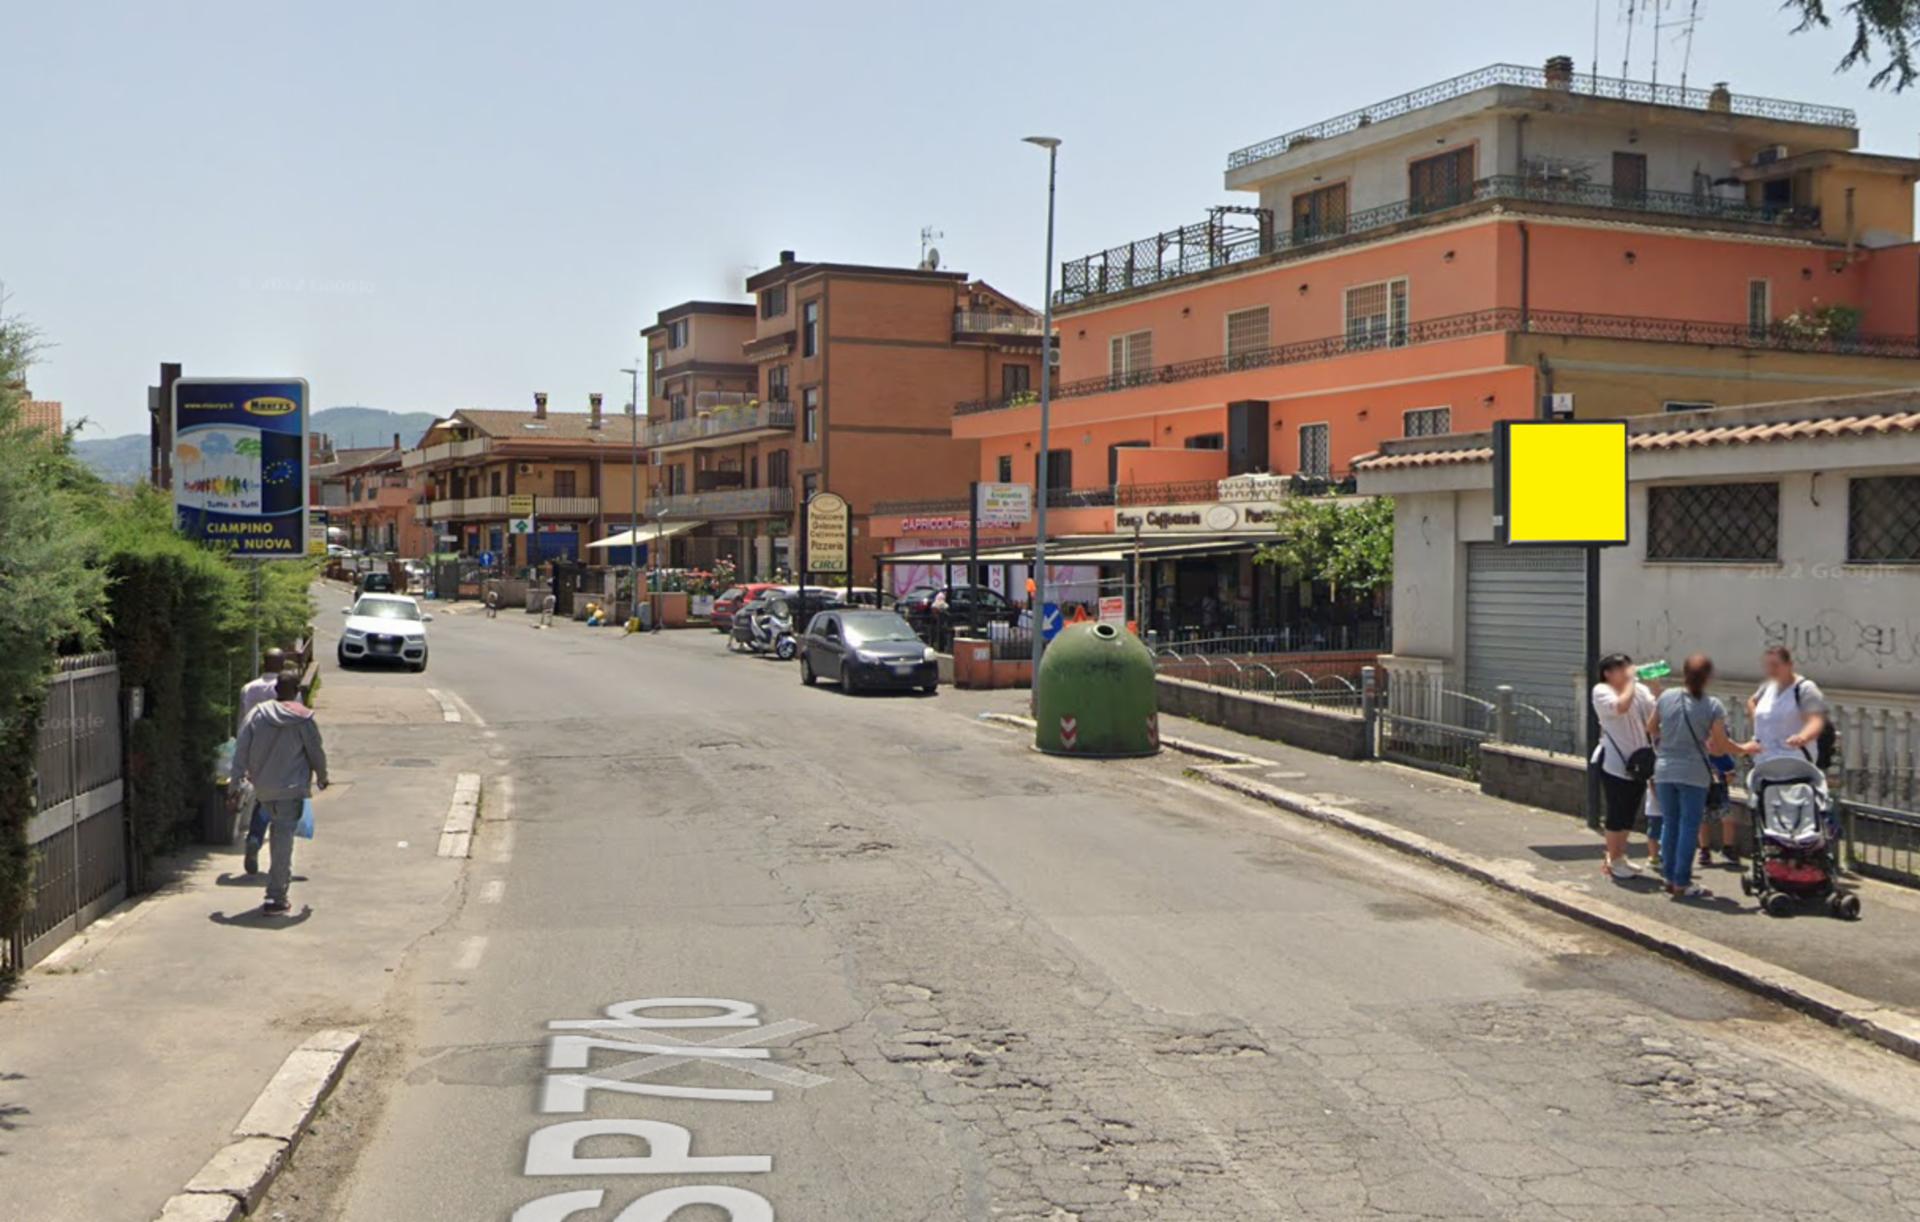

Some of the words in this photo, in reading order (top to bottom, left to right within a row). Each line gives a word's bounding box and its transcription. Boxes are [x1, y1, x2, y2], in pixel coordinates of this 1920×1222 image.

[240, 500, 259, 508] Tutti
[207, 522, 273, 533] CIAMPINO
[244, 539, 292, 549] NUOVA
